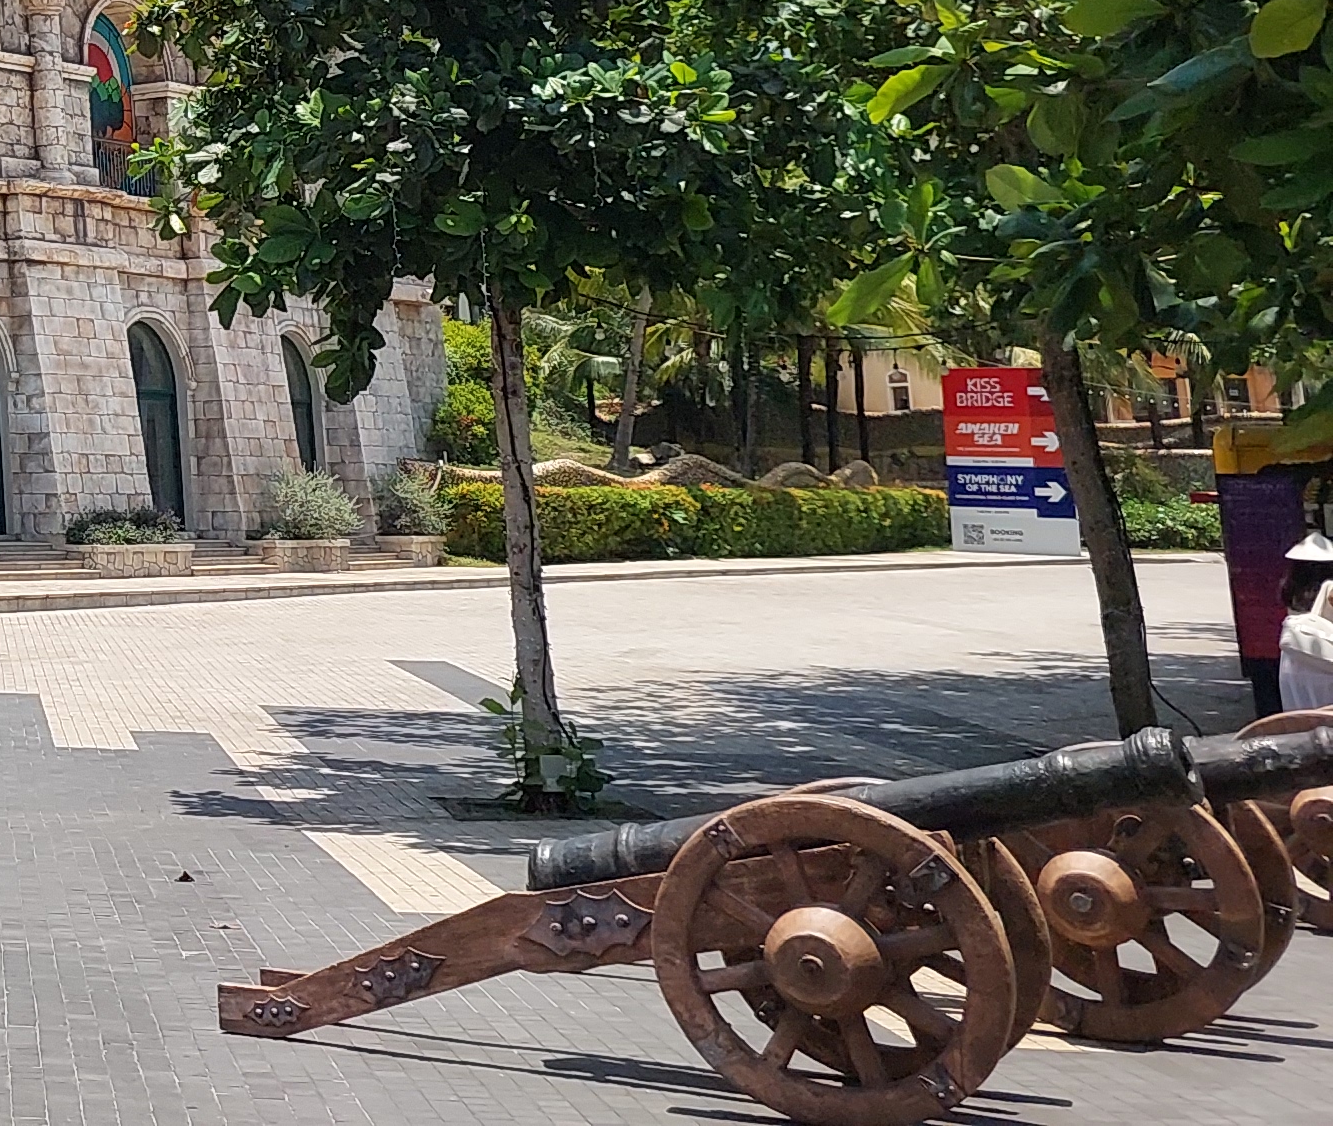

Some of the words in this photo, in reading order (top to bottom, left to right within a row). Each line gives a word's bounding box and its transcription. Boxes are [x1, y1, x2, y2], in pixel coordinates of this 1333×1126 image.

[966, 378, 1000, 391] KISS
[956, 392, 1014, 406] BRIDGE
[955, 422, 1020, 434] AWAKEN
[973, 433, 1002, 445] SEA
[956, 473, 1024, 485] SYMPHONY
[965, 484, 979, 492] OF
[981, 484, 998, 492] THE
[999, 485, 1017, 493] SEA
